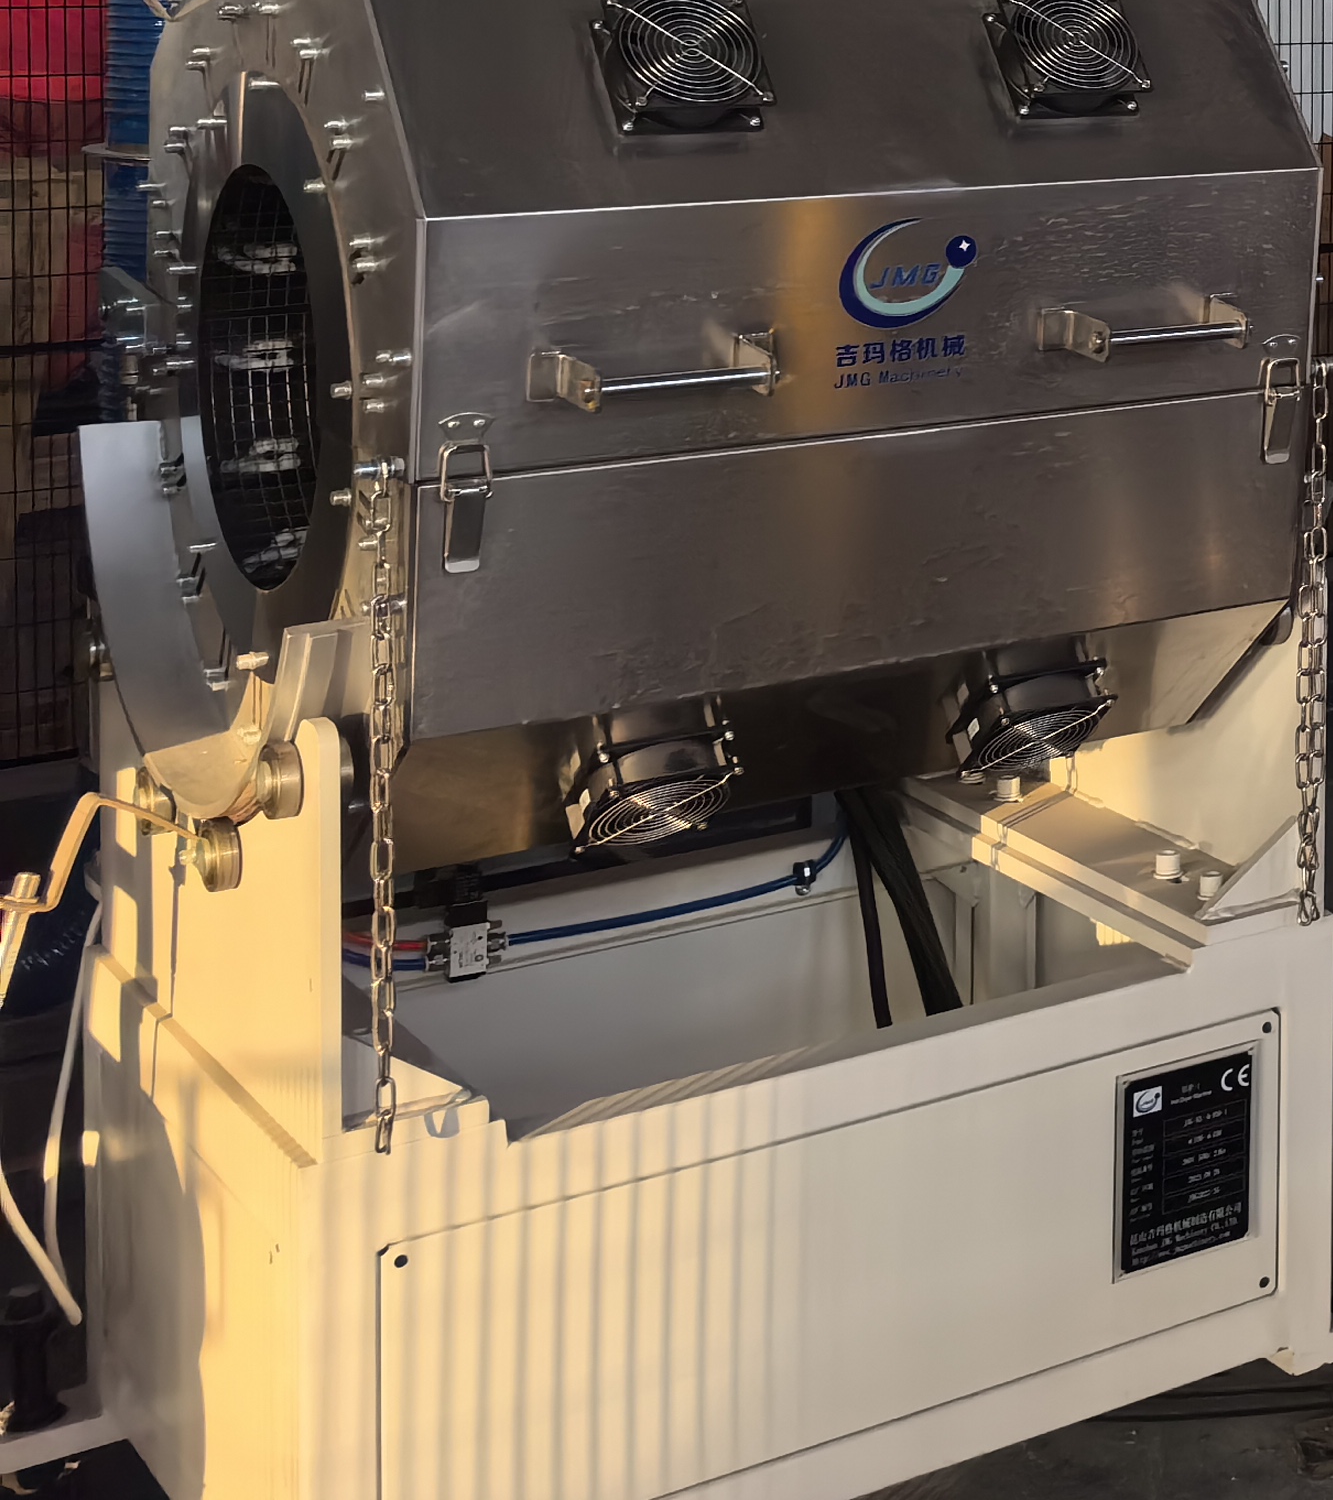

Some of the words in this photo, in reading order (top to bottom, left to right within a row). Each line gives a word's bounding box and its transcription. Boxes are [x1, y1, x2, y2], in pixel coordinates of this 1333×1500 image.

[869, 263, 942, 289] JMG
[835, 334, 967, 367] 吉玛格机械
[834, 372, 871, 389] JMG
[1220, 1063, 1250, 1091] CE
